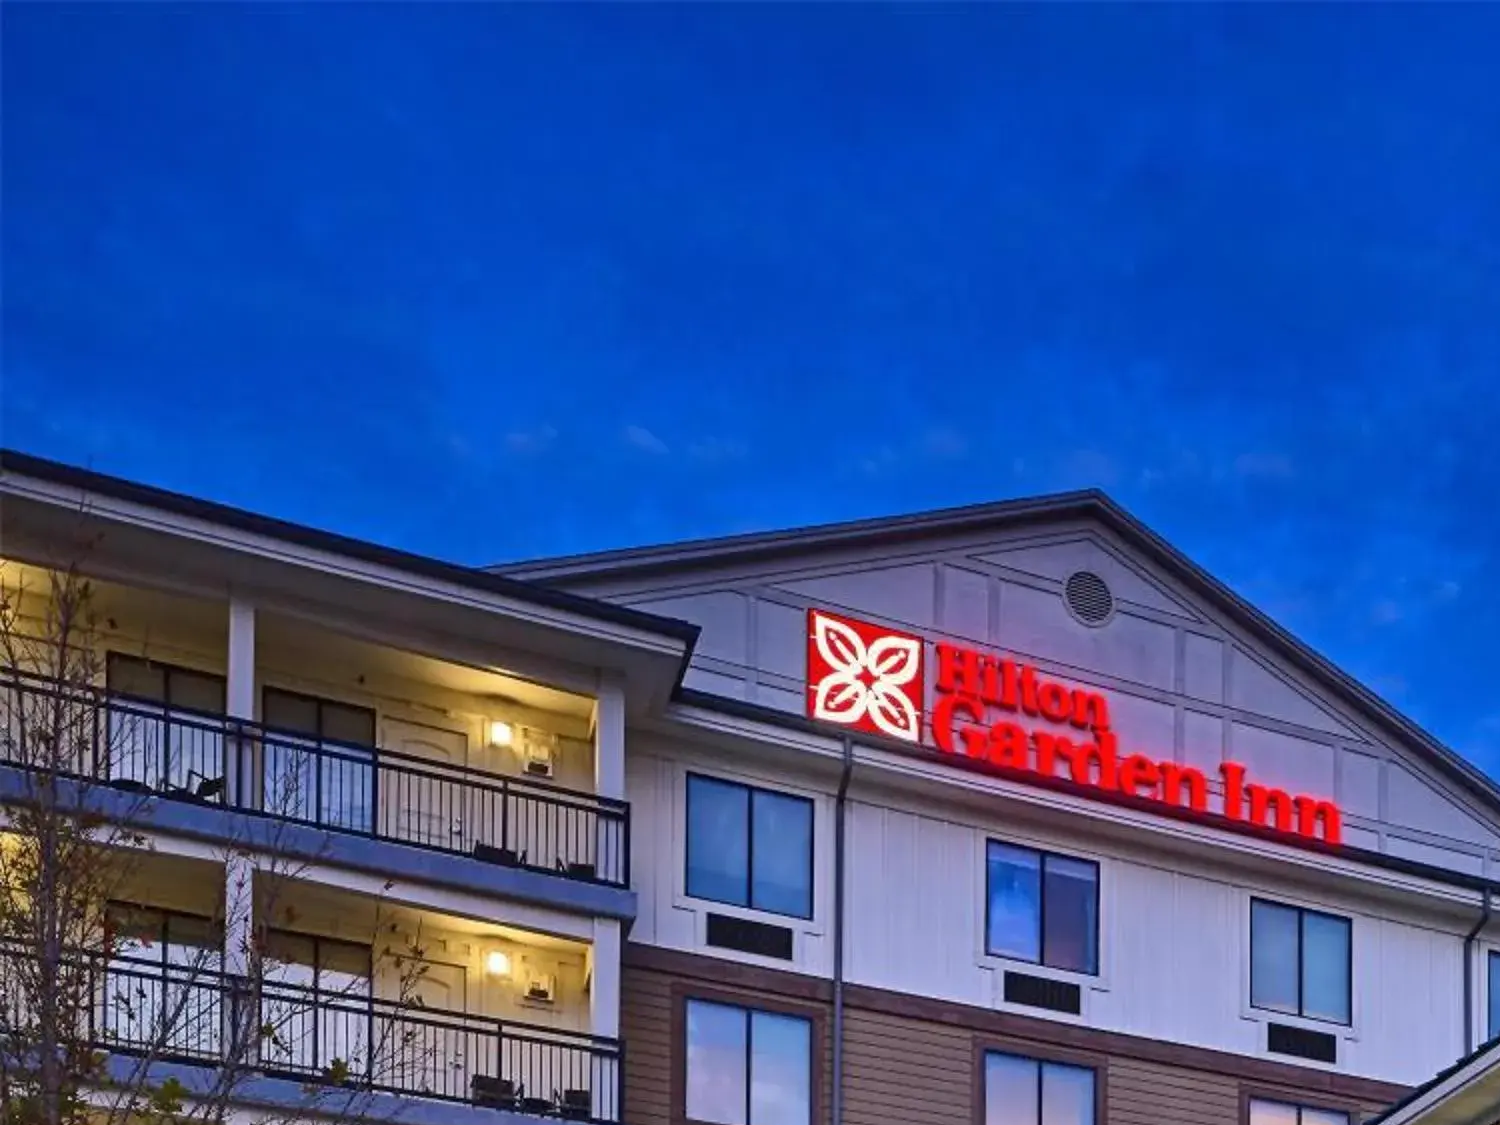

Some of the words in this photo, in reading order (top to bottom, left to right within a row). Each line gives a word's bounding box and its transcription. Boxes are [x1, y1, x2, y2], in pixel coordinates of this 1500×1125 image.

[936, 642, 1111, 732] Hilton
[932, 694, 1208, 813] Garden
[1219, 761, 1342, 845] Inn
